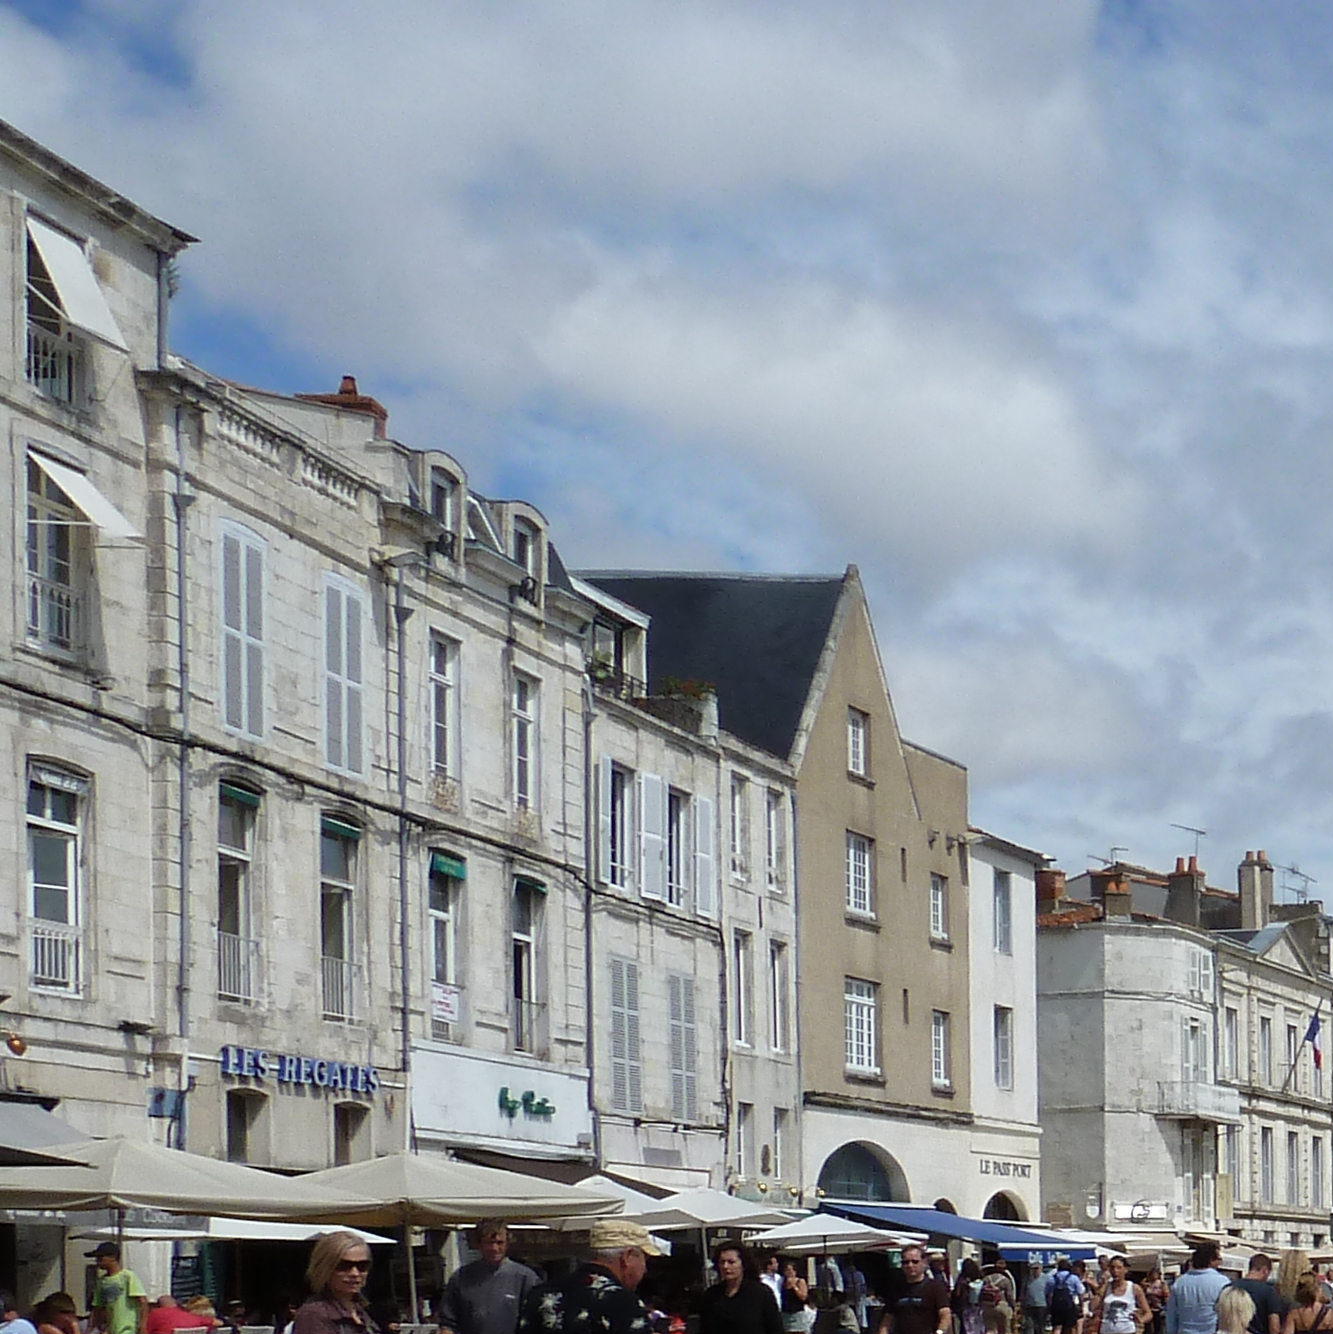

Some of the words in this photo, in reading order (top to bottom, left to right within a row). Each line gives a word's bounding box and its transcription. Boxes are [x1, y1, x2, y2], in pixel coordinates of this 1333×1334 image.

[222, 1045, 270, 1078] LES
[278, 1055, 381, 1094] REGATES
[980, 1159, 990, 1174] LE
